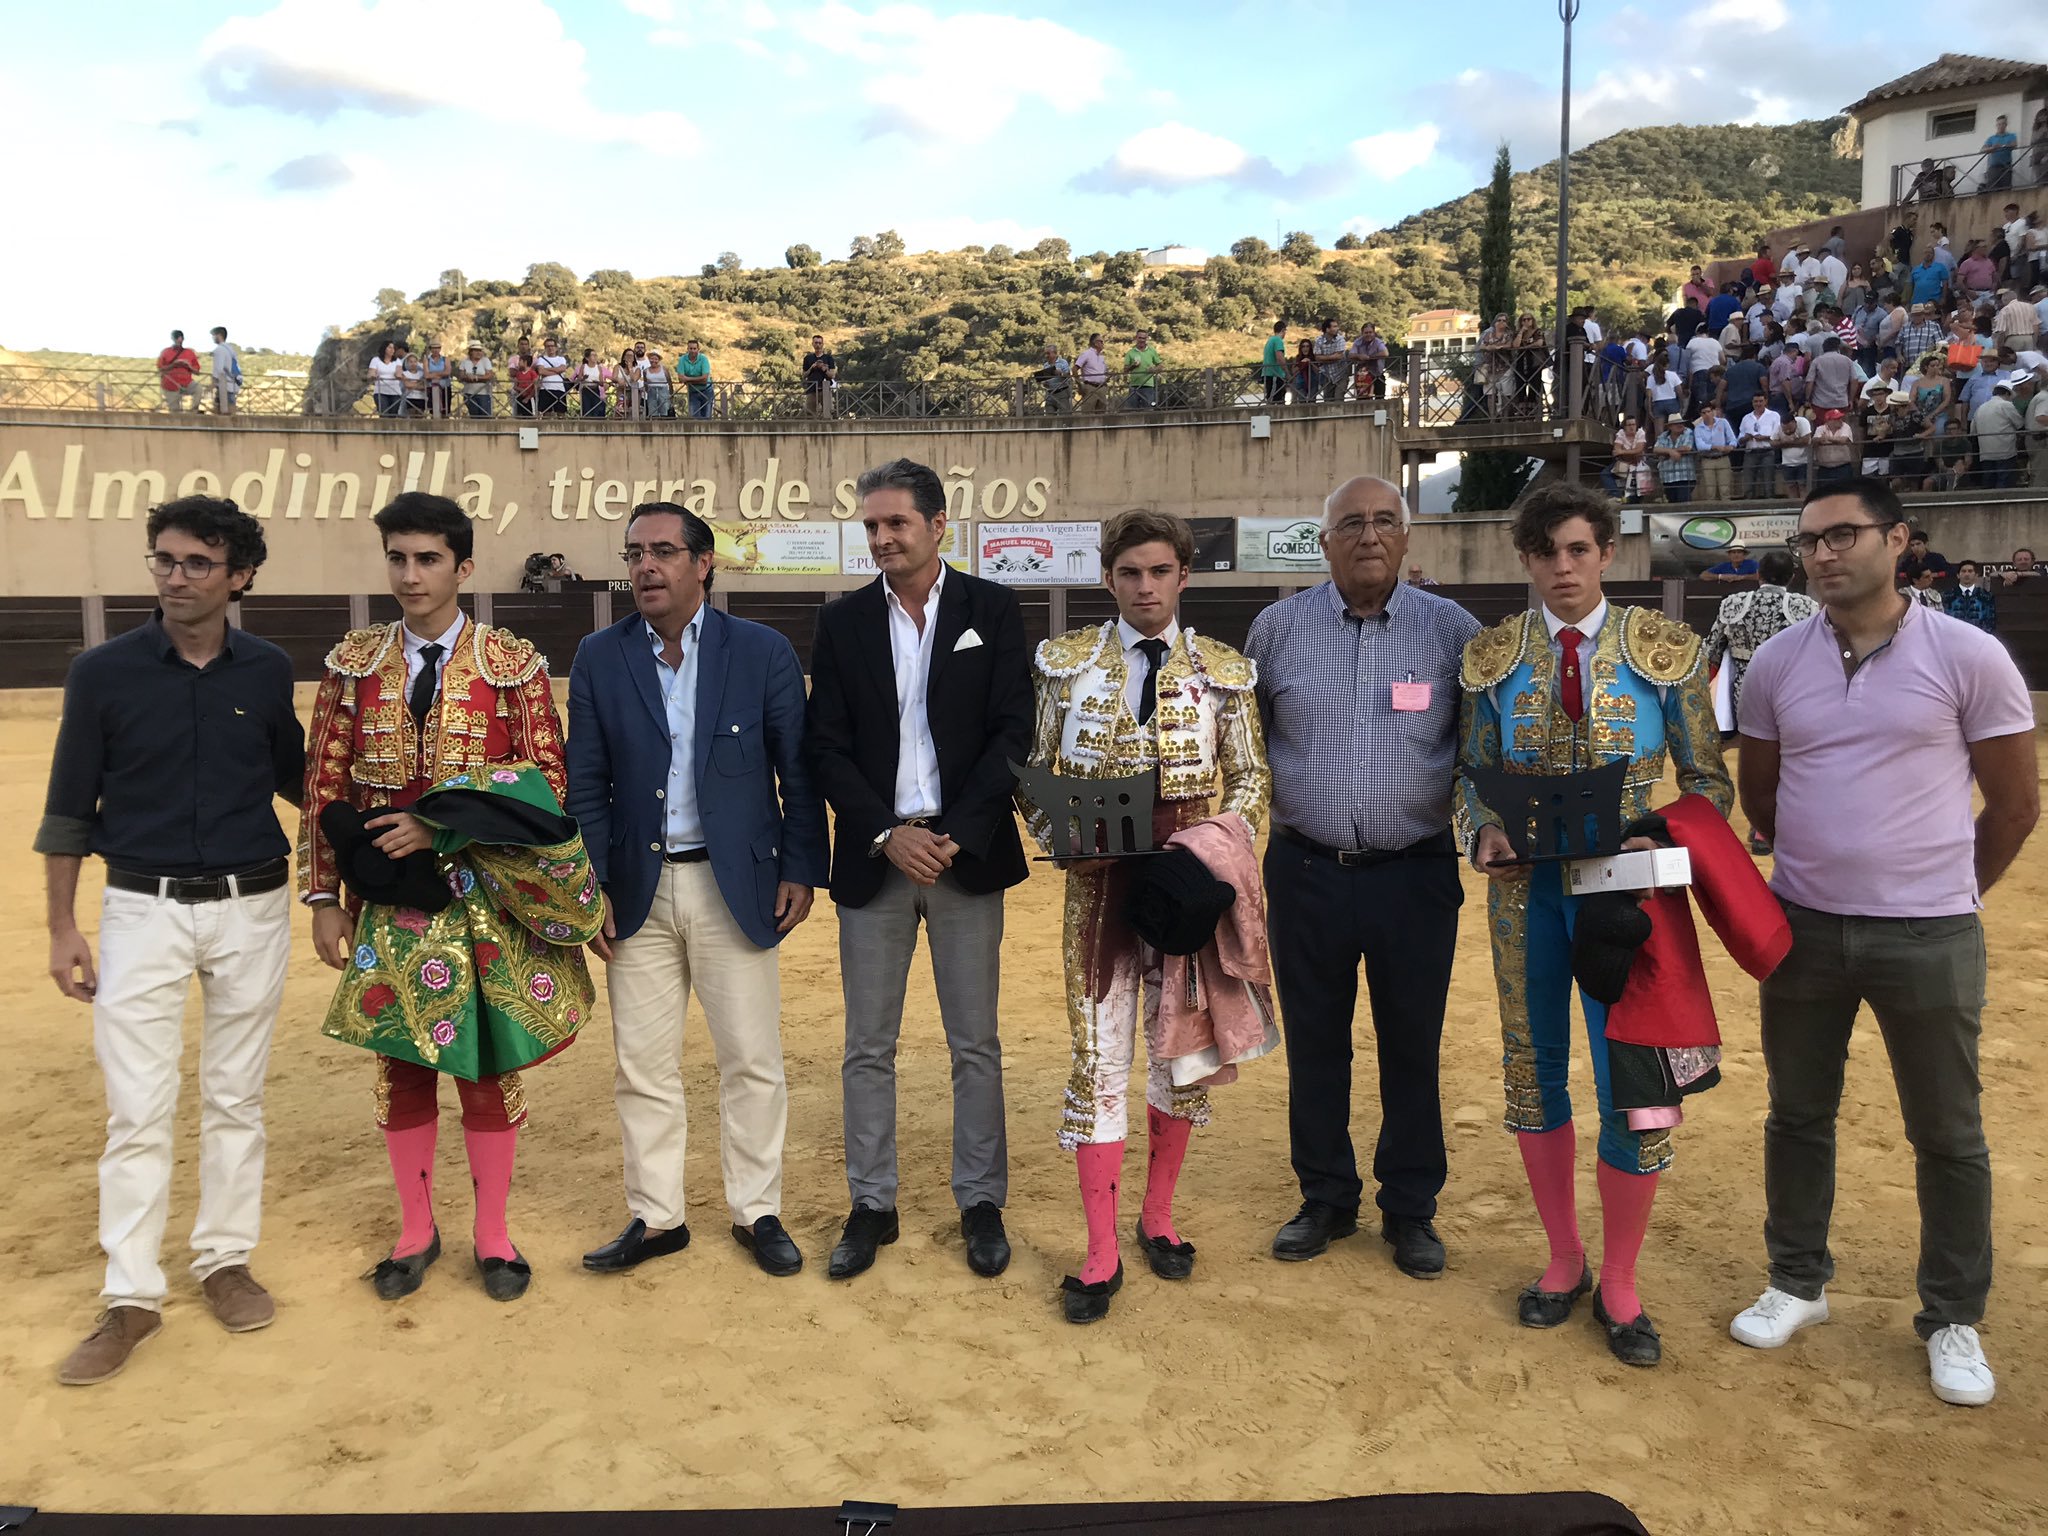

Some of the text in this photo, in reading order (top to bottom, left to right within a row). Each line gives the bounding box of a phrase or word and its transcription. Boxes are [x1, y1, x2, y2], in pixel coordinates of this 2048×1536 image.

[0, 444, 1052, 535] Almedinilla, tierra de sños
[982, 524, 1098, 535] Aceite de Oliva Virgen Extra
[990, 540, 1018, 548] MANUEL
[1020, 539, 1047, 548] MOLINA
[857, 557, 878, 570] PU
